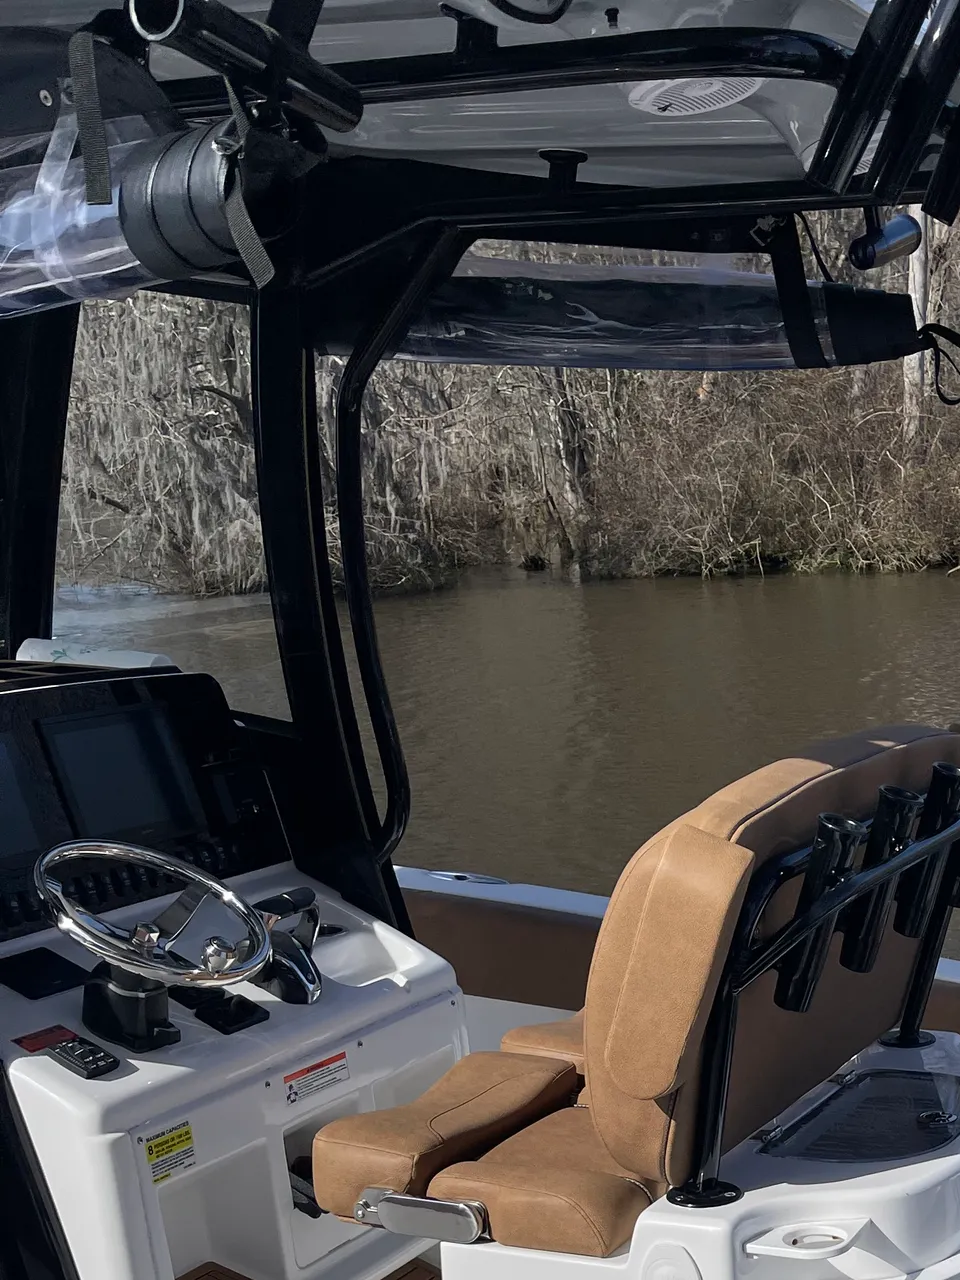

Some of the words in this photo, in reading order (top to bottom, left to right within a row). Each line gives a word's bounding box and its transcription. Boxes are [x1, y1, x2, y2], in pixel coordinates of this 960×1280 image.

[146, 1131, 165, 1143] MAXIMUM
[166, 1121, 189, 1134] CAPACITIES
[148, 1145, 154, 1155] 8
